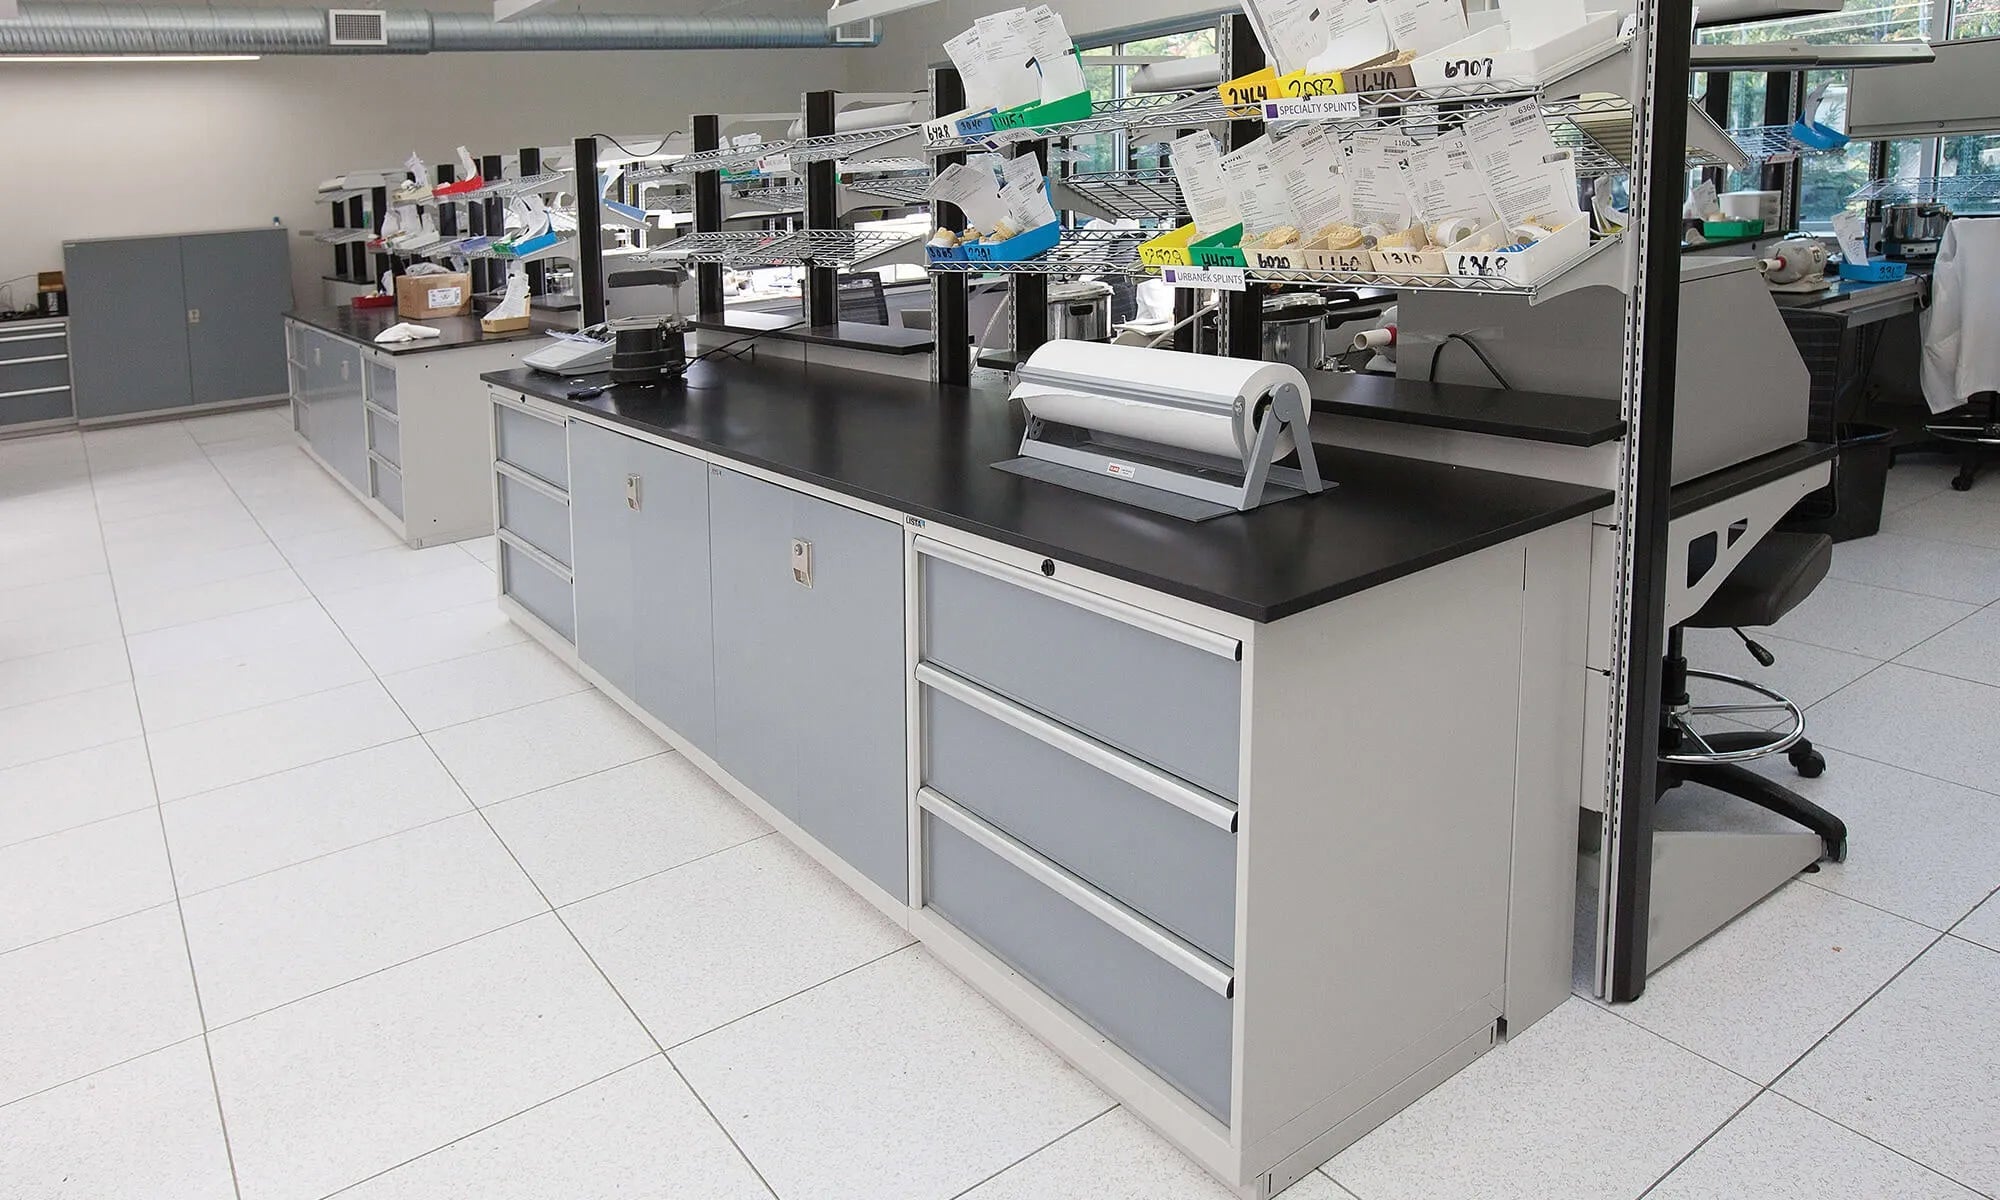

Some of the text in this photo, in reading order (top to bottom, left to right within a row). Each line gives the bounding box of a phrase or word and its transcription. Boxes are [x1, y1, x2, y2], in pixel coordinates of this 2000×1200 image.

[1444, 57, 1493, 79] 6707
[1288, 78, 1338, 99] 2083
[1355, 71, 1397, 93] 1640
[1279, 101, 1357, 115] SPECIALTY SPLINTS
[1517, 103, 1536, 114] 6368
[927, 123, 951, 141] 6428
[1307, 124, 1322, 137] 6020
[1394, 139, 1411, 147] 1160
[1201, 253, 1235, 267] 4407
[1257, 253, 1291, 269] 6020
[1318, 255, 1362, 272] 1160
[1382, 252, 1423, 265] 1310
[1458, 255, 1509, 277] 6368
[1177, 272, 1243, 284] URBANEK SPLINTS
